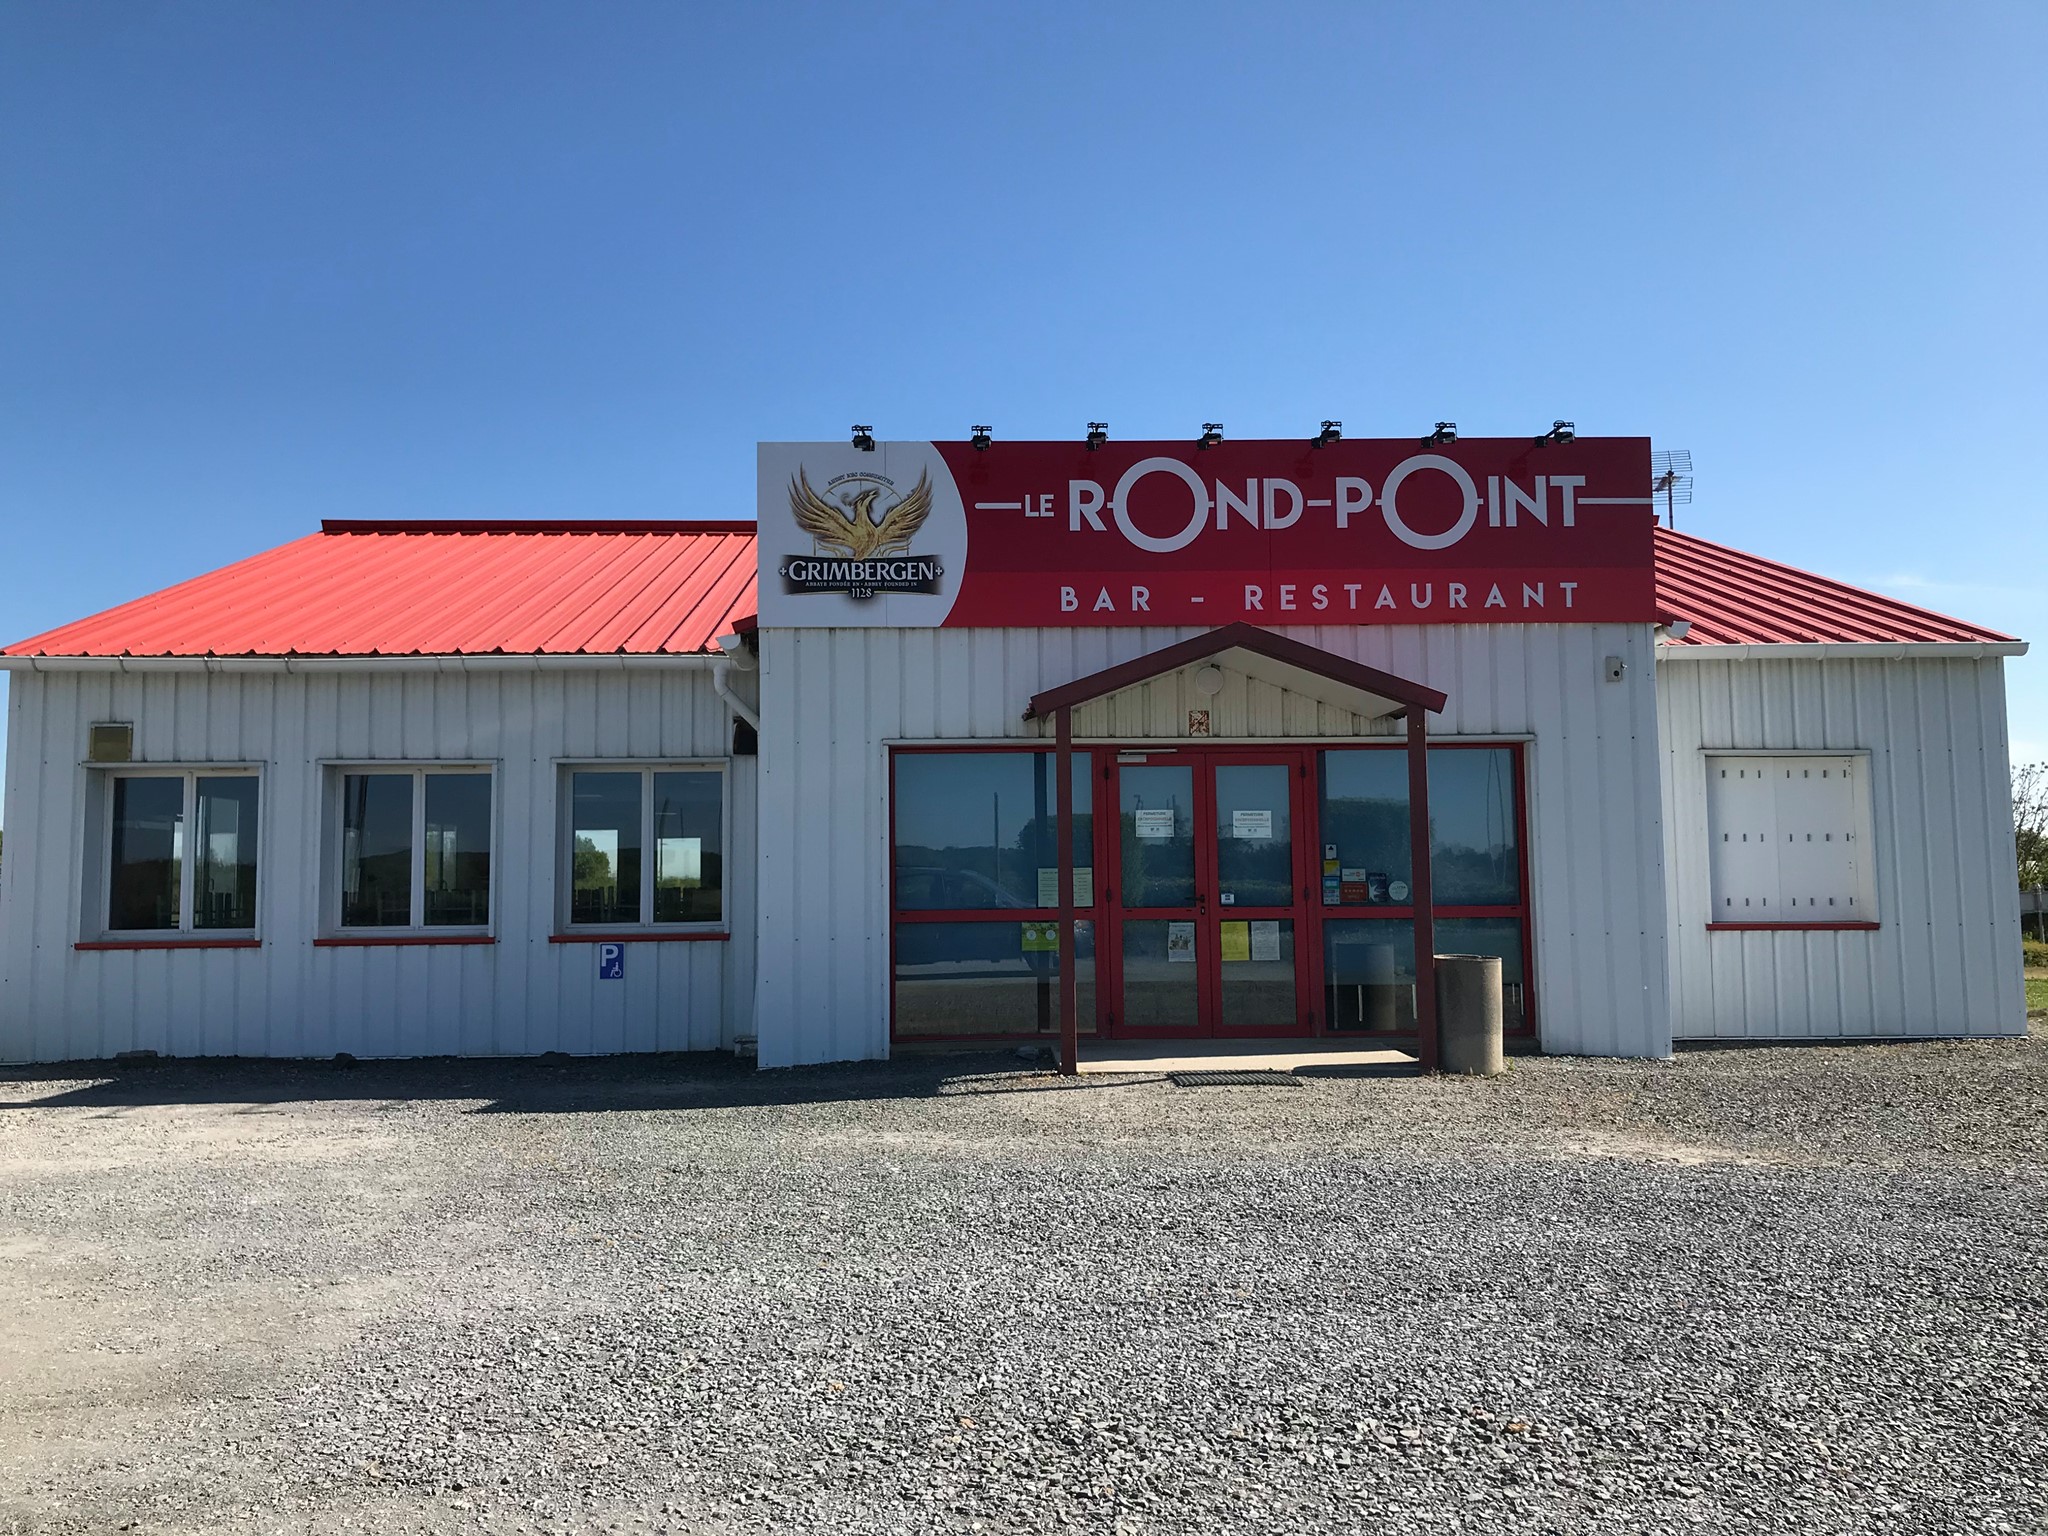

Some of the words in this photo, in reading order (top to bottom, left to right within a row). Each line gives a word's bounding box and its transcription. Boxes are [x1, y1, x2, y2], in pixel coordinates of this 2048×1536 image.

[1024, 494, 1055, 517] LE
[788, 560, 934, 581] GRIMBERGEN
[851, 588, 872, 598] 1128
[1060, 585, 1151, 612] BAR
[1244, 582, 1578, 611] RESTAURANT
[601, 944, 619, 967] P
